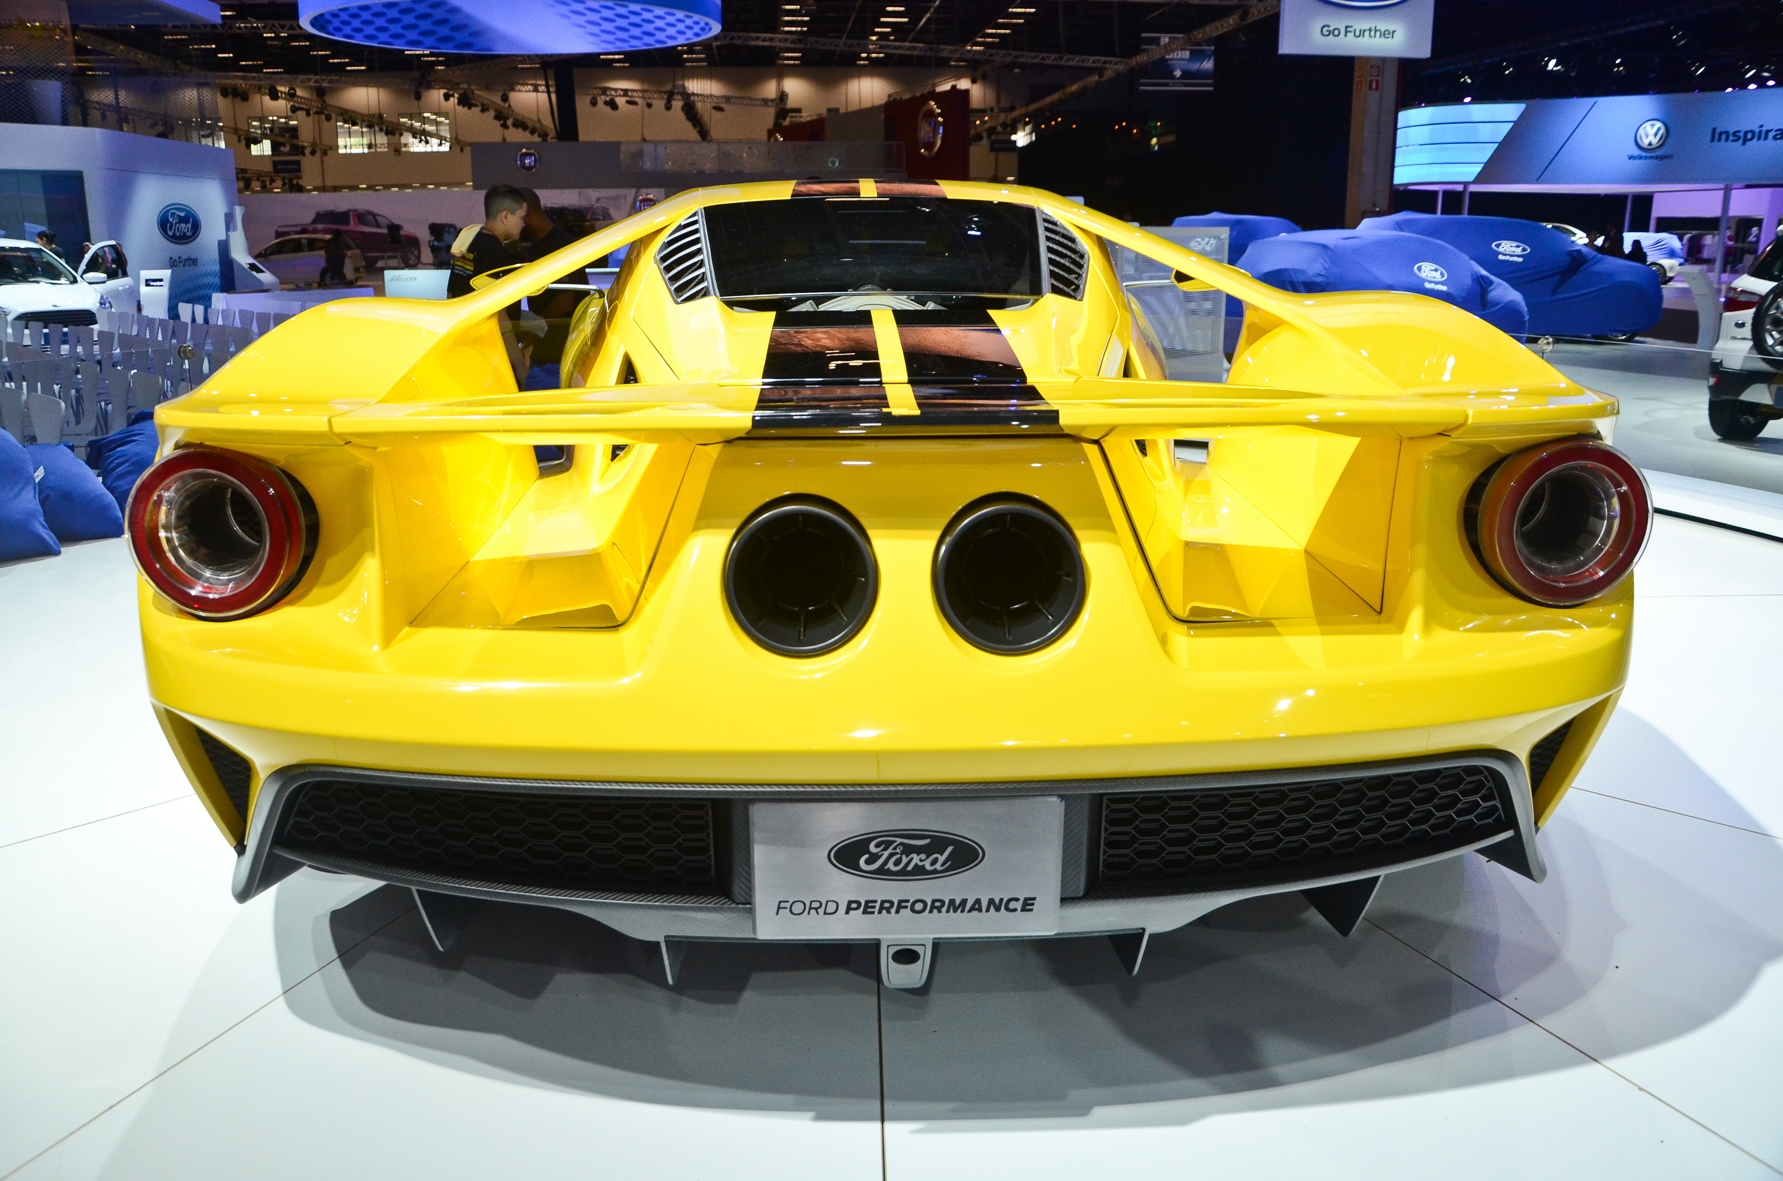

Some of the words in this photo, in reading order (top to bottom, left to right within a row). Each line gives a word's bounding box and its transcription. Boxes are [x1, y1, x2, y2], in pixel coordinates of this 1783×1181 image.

[1320, 24, 1341, 37] Go
[1344, 25, 1397, 39] Further
[1709, 124, 1783, 146] Inspira
[1627, 153, 1674, 162] Volkswagen
[166, 209, 193, 236] Ford
[1498, 241, 1523, 253] Ford
[168, 256, 177, 268] Go
[178, 256, 198, 267] Further
[1420, 262, 1442, 280] Ford
[859, 836, 955, 871] Ford
[775, 899, 840, 916] FORD
[844, 896, 1037, 915] PERFORMANCE
